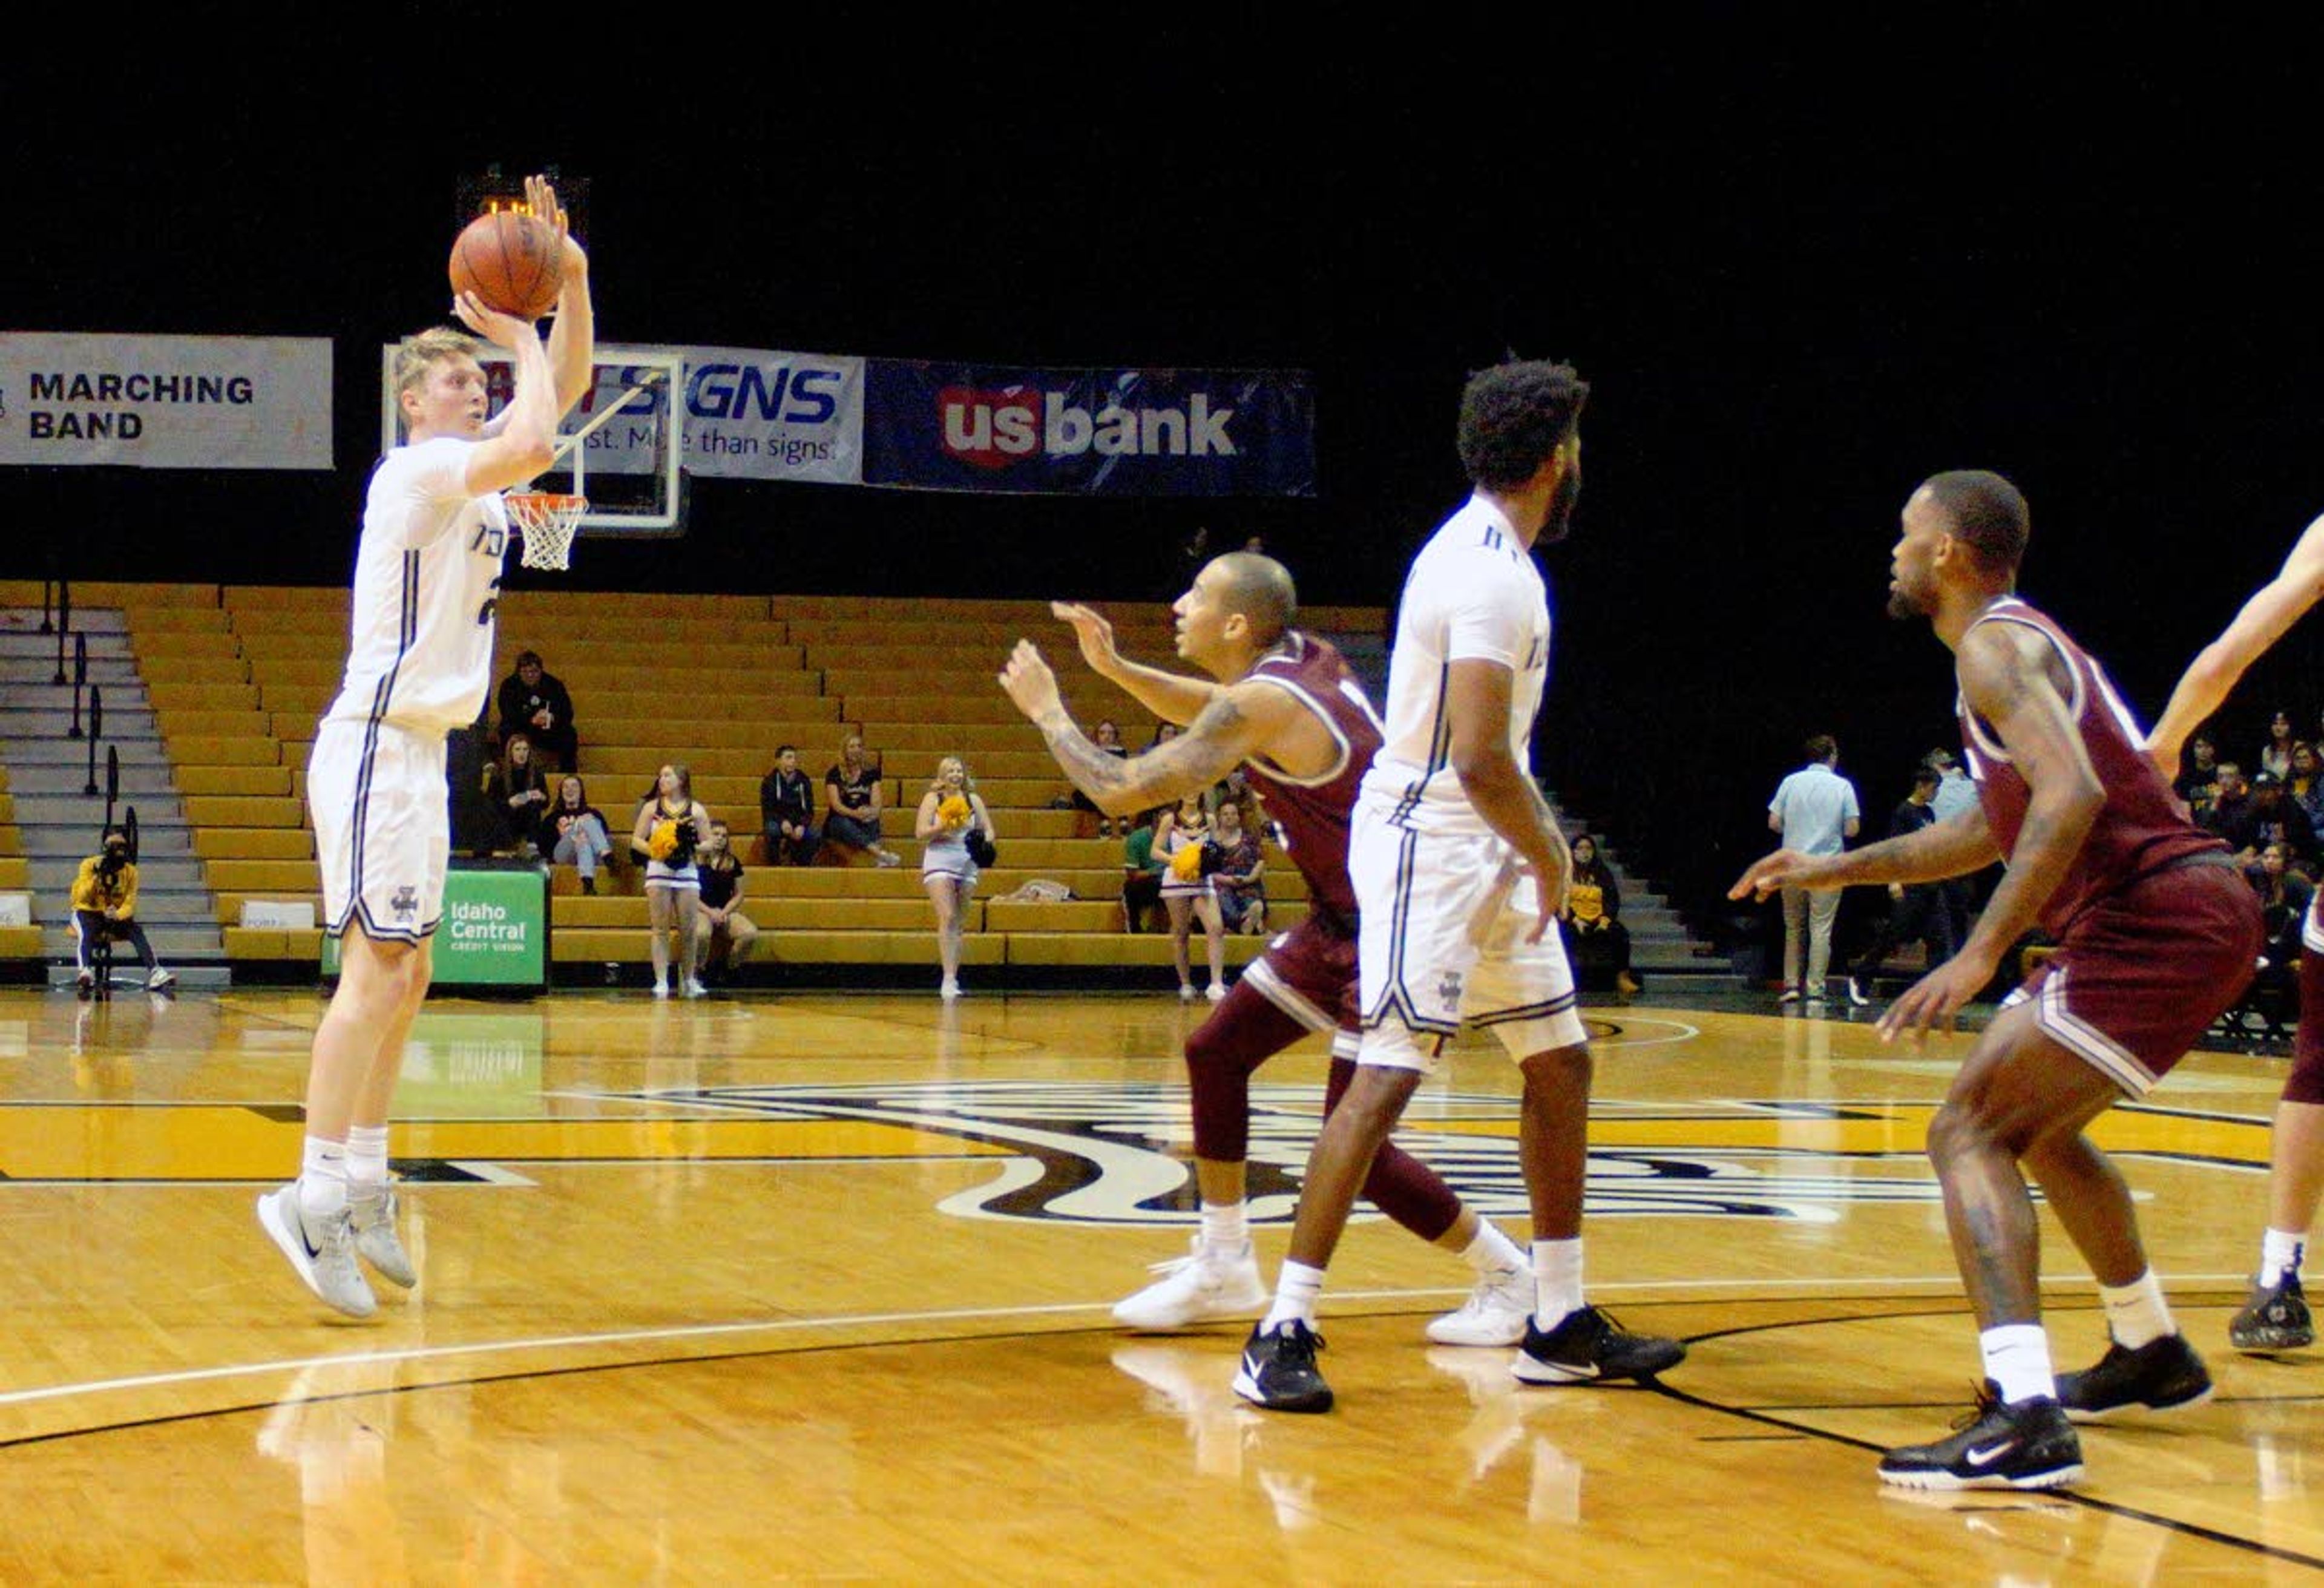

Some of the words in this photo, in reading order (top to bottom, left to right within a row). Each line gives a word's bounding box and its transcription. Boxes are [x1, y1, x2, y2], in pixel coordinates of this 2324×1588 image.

[30, 373, 253, 404] MARCHING
[30, 411, 143, 439] BAND
[702, 428, 758, 454] than
[451, 902, 506, 920] Idaho
[451, 921, 527, 940] Central
